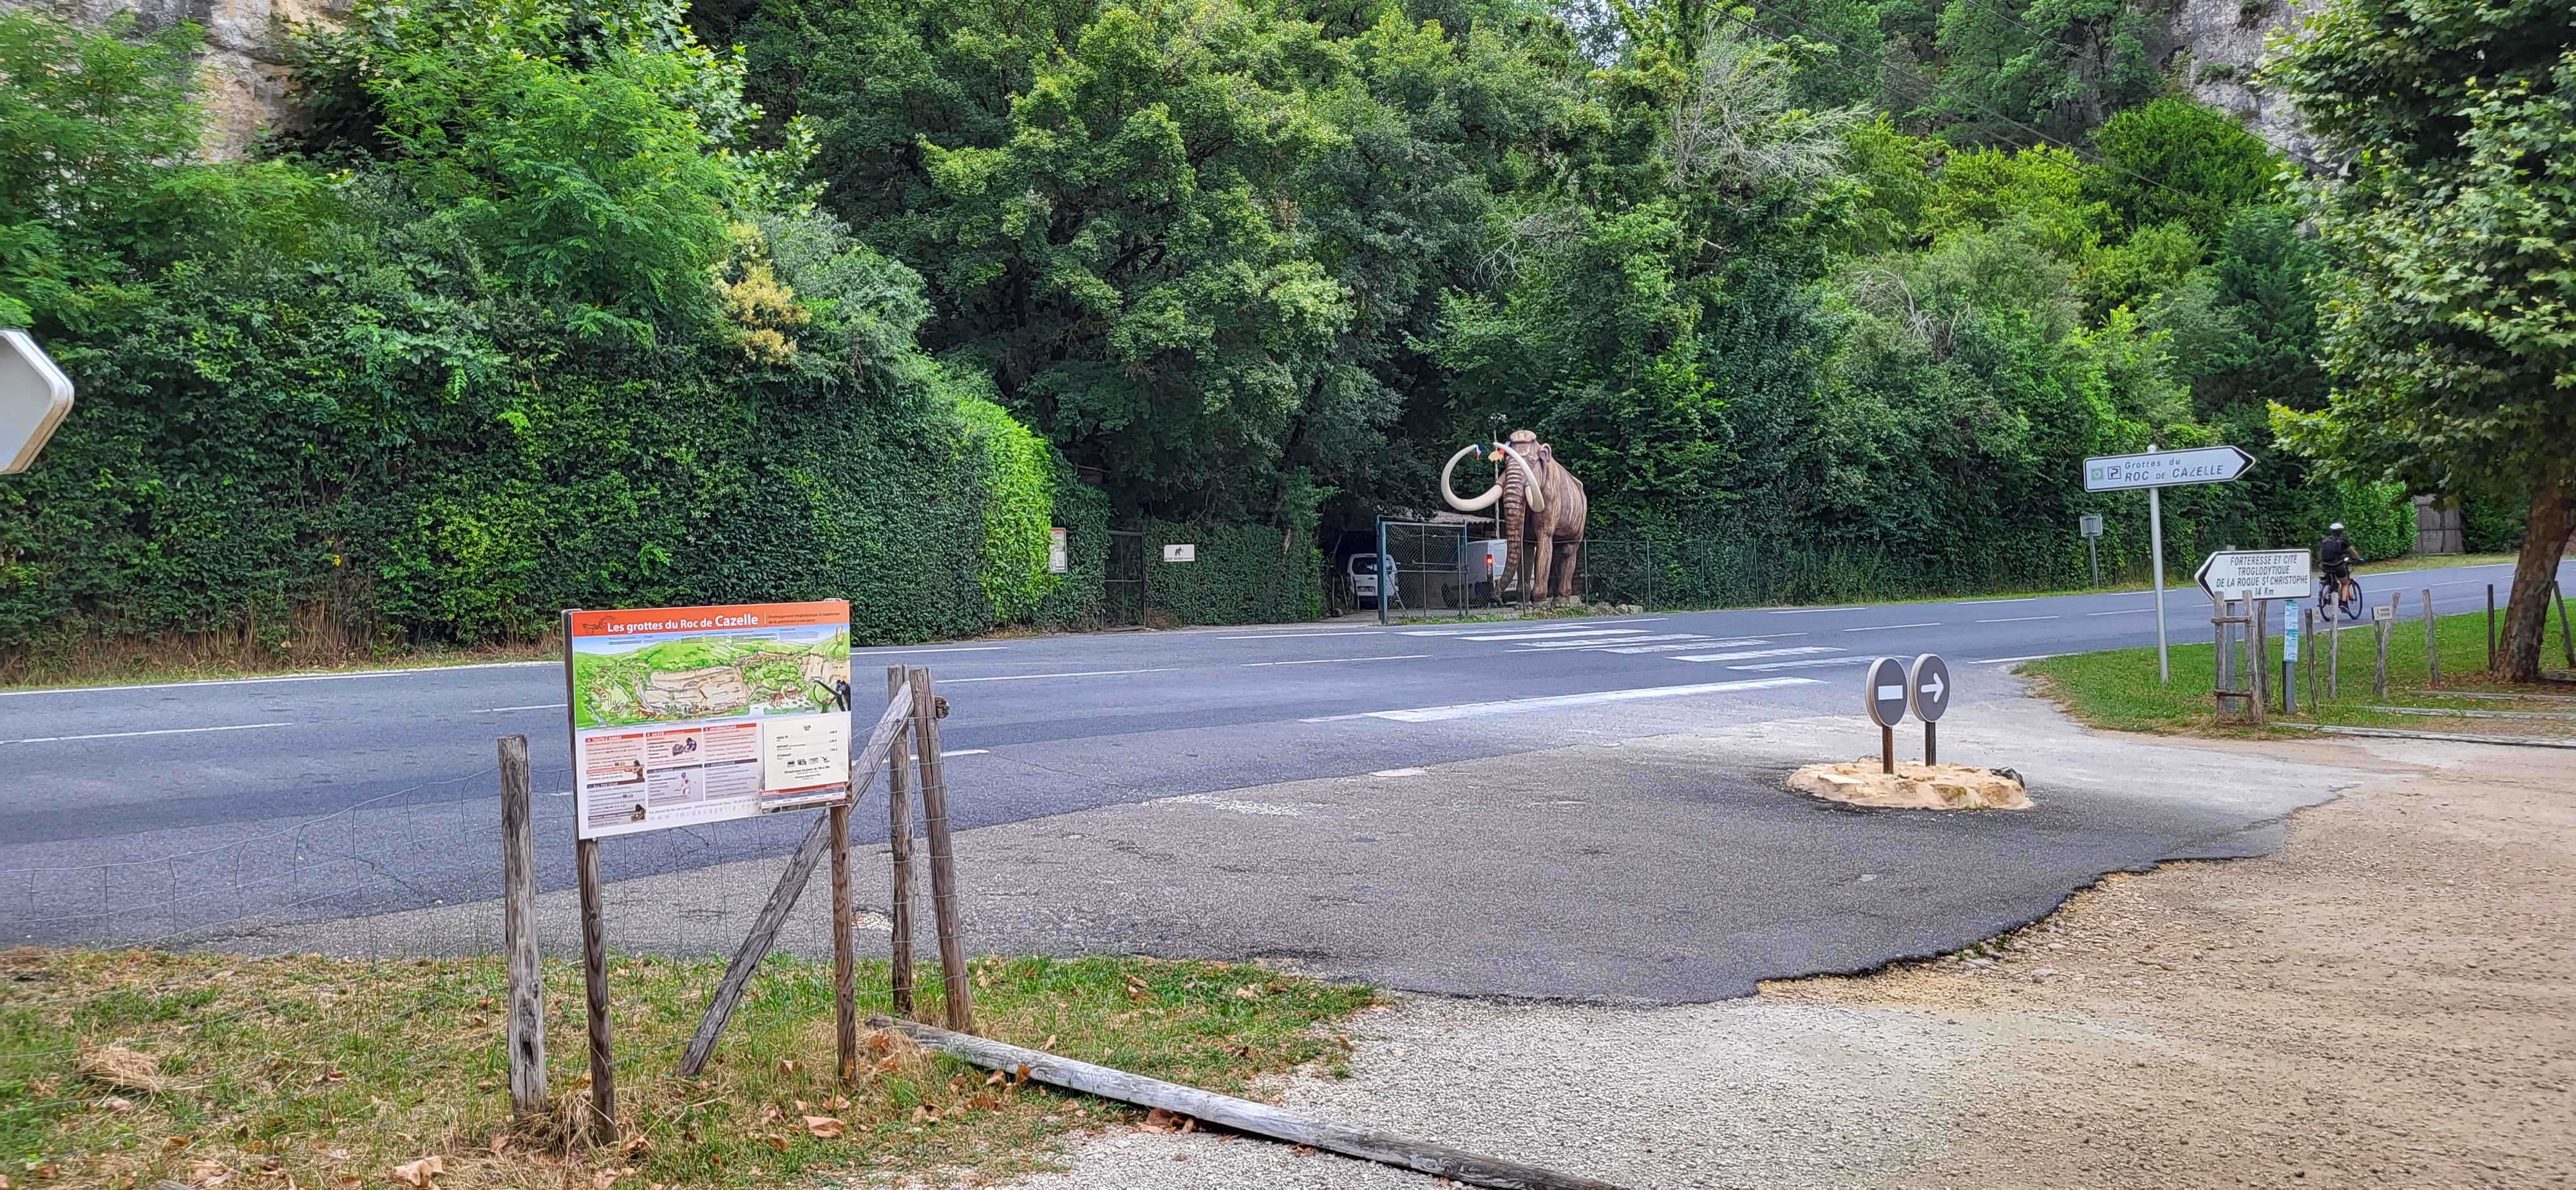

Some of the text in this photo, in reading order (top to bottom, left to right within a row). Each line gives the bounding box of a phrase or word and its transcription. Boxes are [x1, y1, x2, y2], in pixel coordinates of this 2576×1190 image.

[2125, 460, 2161, 469] Grottes
[2125, 471, 2150, 482] ROC
[2172, 464, 2224, 479] CAZELLE
[2230, 553, 2298, 566] FORTERESSE ET CITÉ
[2238, 565, 2290, 576] TROGLODYTIQUE
[2216, 578, 2225, 587] DE
[2226, 578, 2235, 587] LA
[2237, 577, 2260, 587] ROQUE
[2270, 575, 2308, 585] CHRISTOPHE
[2255, 587, 2274, 596] 14 Km
[607, 613, 759, 634] Les grottes du Roc de Cazelle
